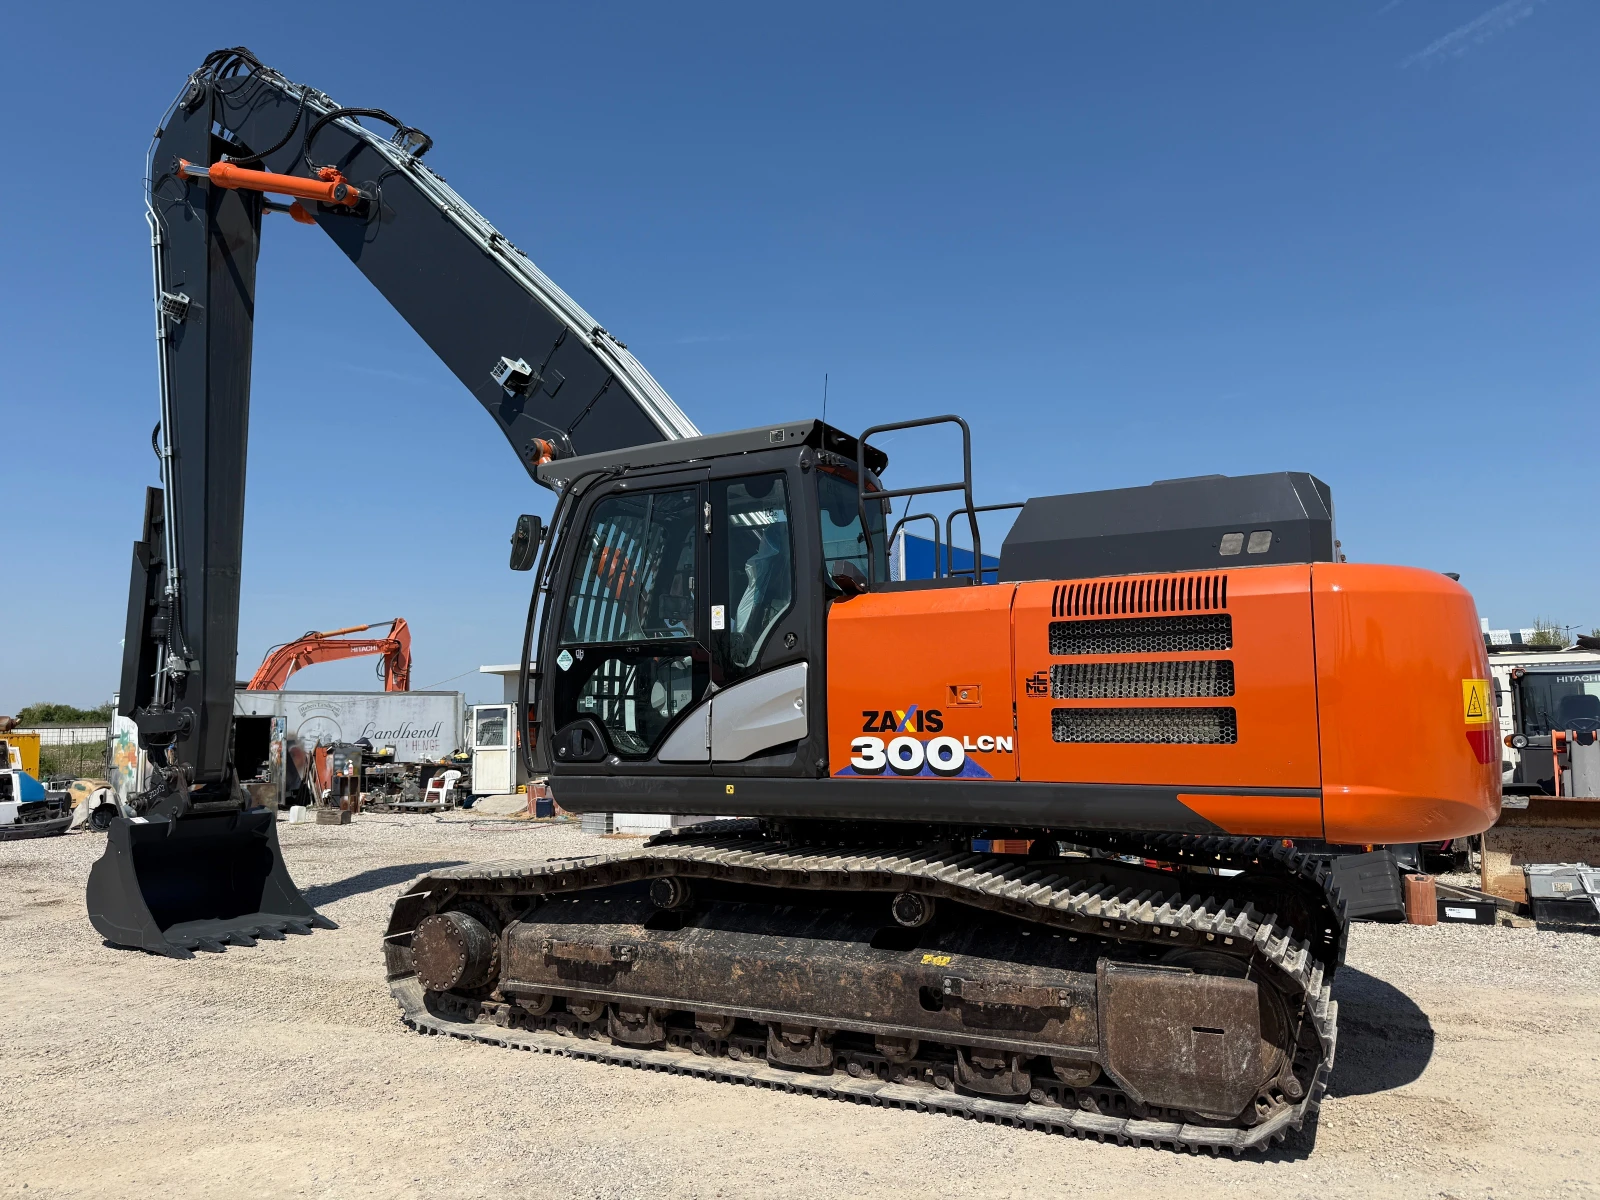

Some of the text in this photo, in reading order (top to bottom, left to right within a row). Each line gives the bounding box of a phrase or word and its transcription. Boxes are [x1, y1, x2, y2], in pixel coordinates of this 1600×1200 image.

[1556, 674, 1600, 683] HITACHI
[862, 704, 944, 733] ZAXIS
[361, 721, 444, 740] Landhendl
